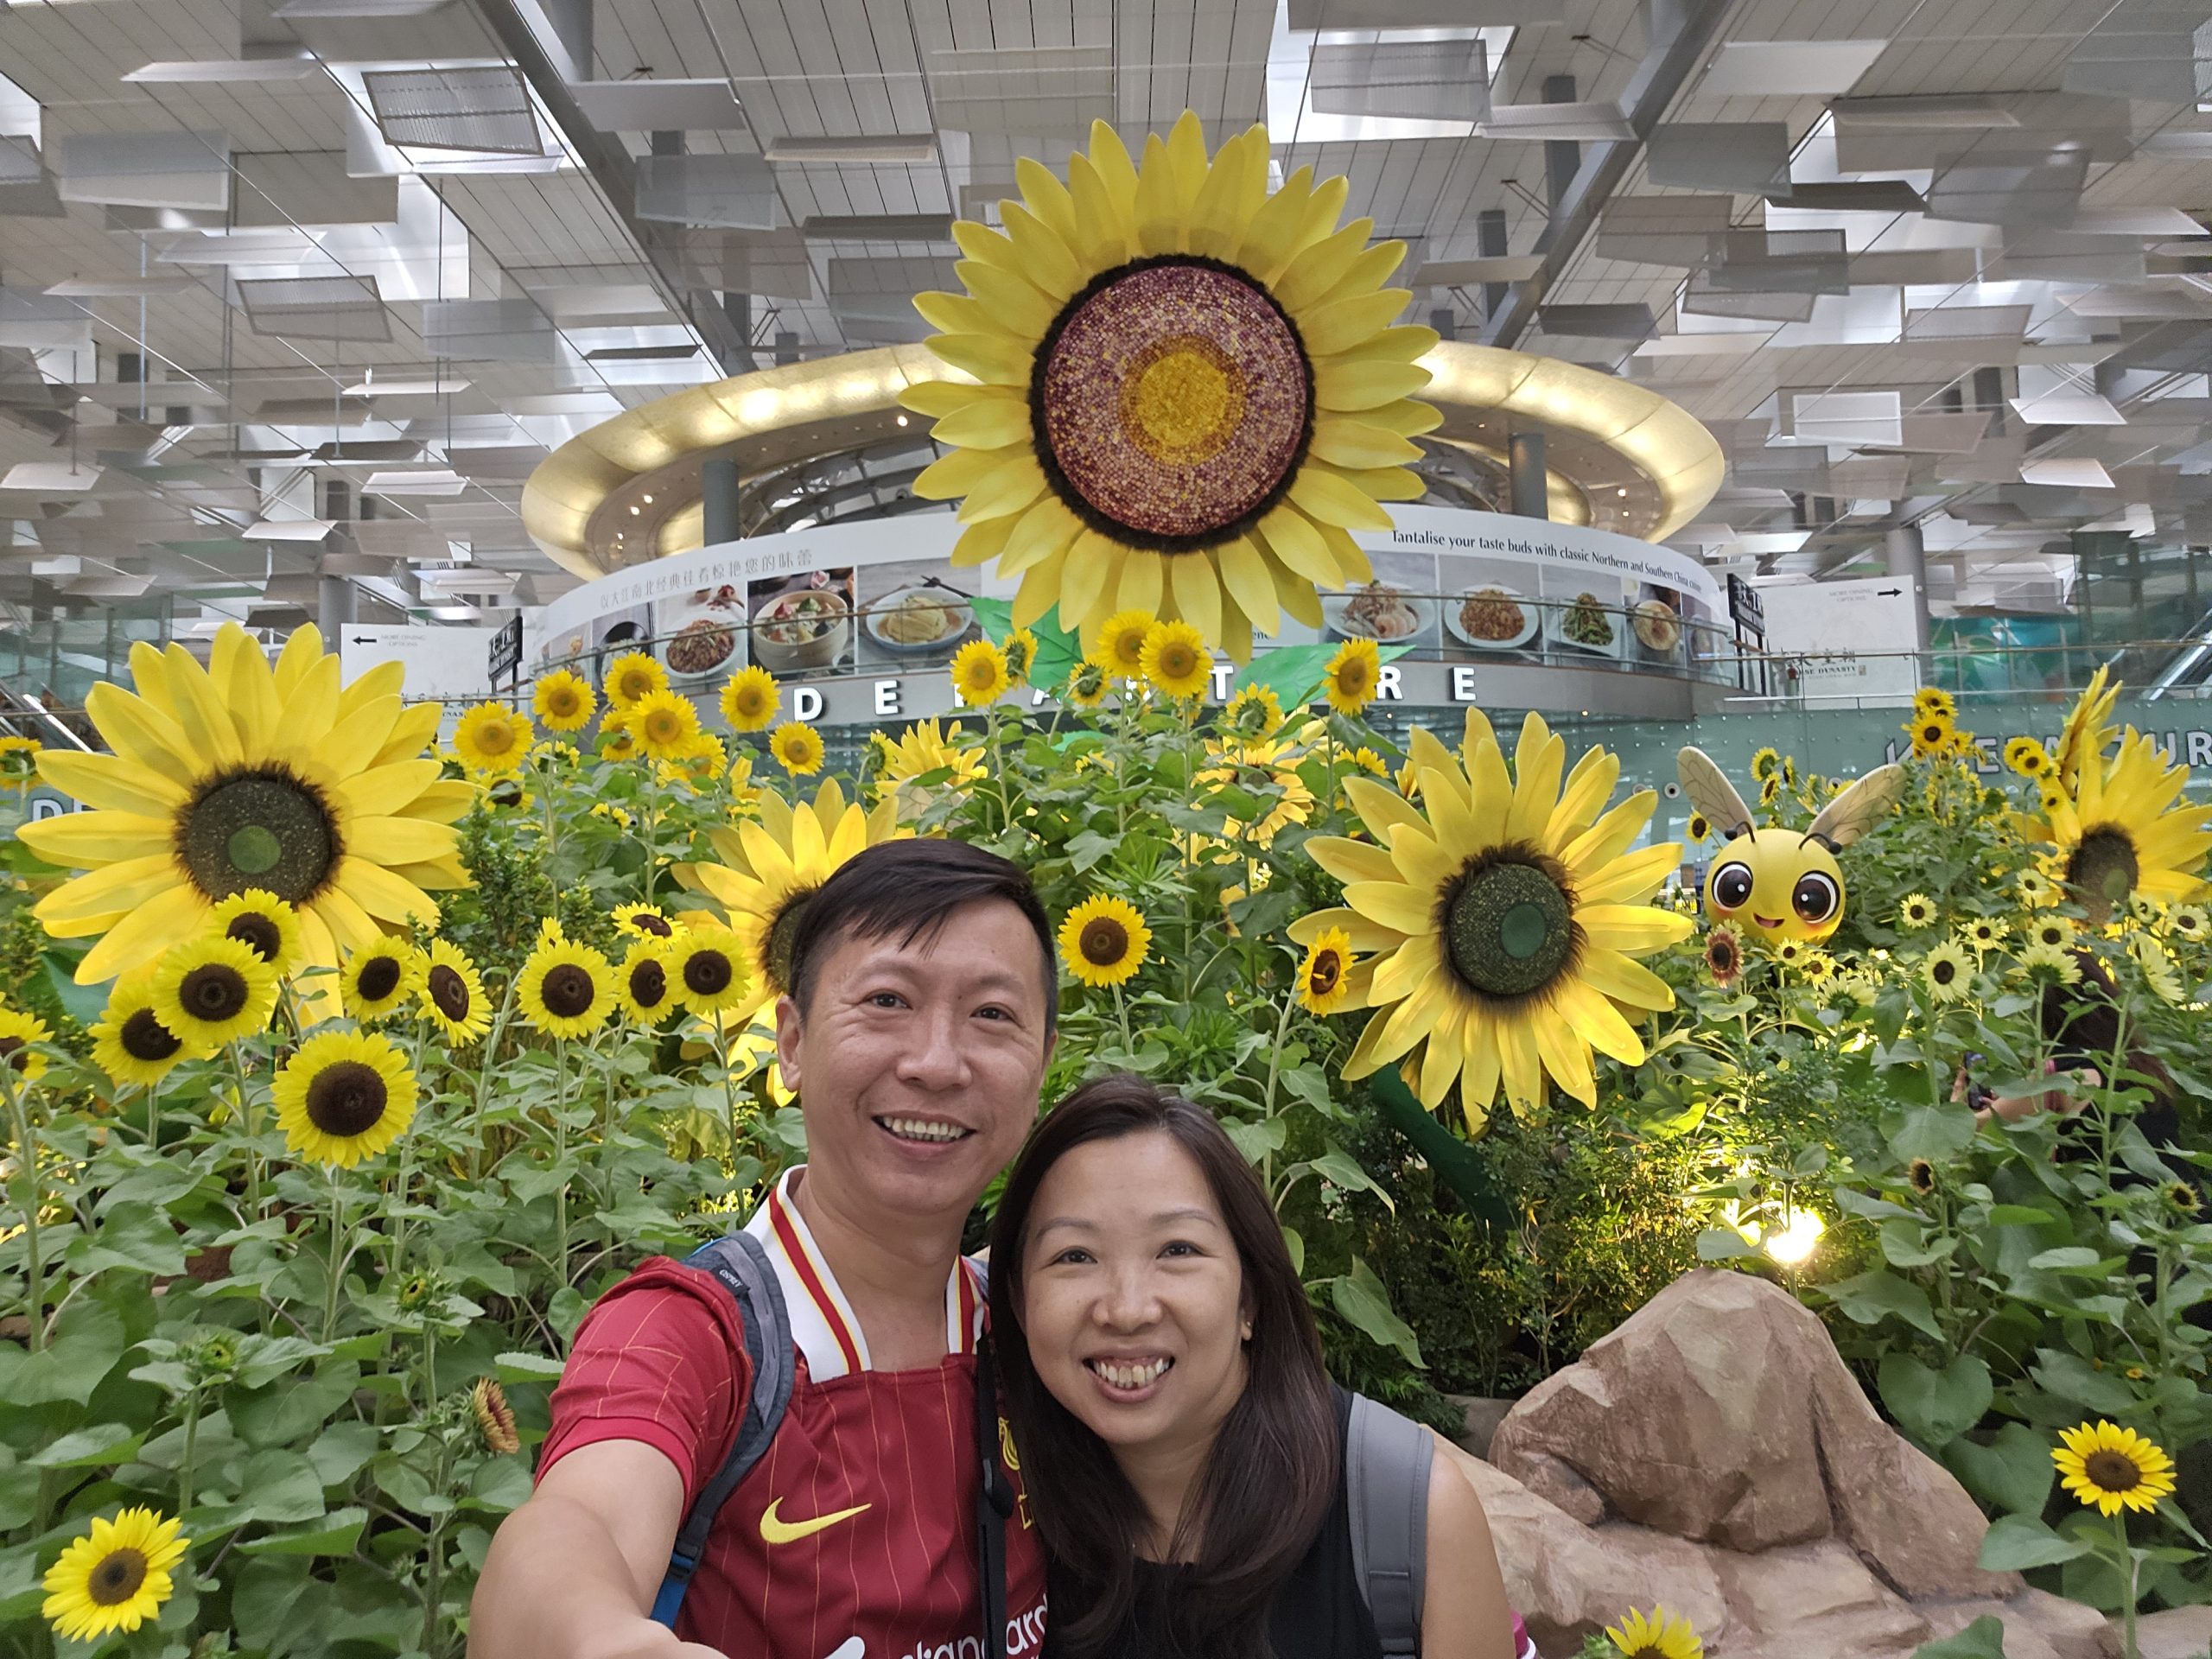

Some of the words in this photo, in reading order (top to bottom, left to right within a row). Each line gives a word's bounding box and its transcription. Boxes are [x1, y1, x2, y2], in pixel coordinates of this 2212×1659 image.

[1392, 530, 1446, 545] Tantalise
[1448, 536, 1476, 551] your
[1479, 537, 1505, 551] taste
[1508, 538, 1533, 555] buds
[1535, 543, 1557, 557] with
[1560, 546, 1589, 563] classic
[1592, 550, 1629, 570] Northern
[1630, 561, 1643, 572] and
[1644, 563, 1674, 581] Southern
